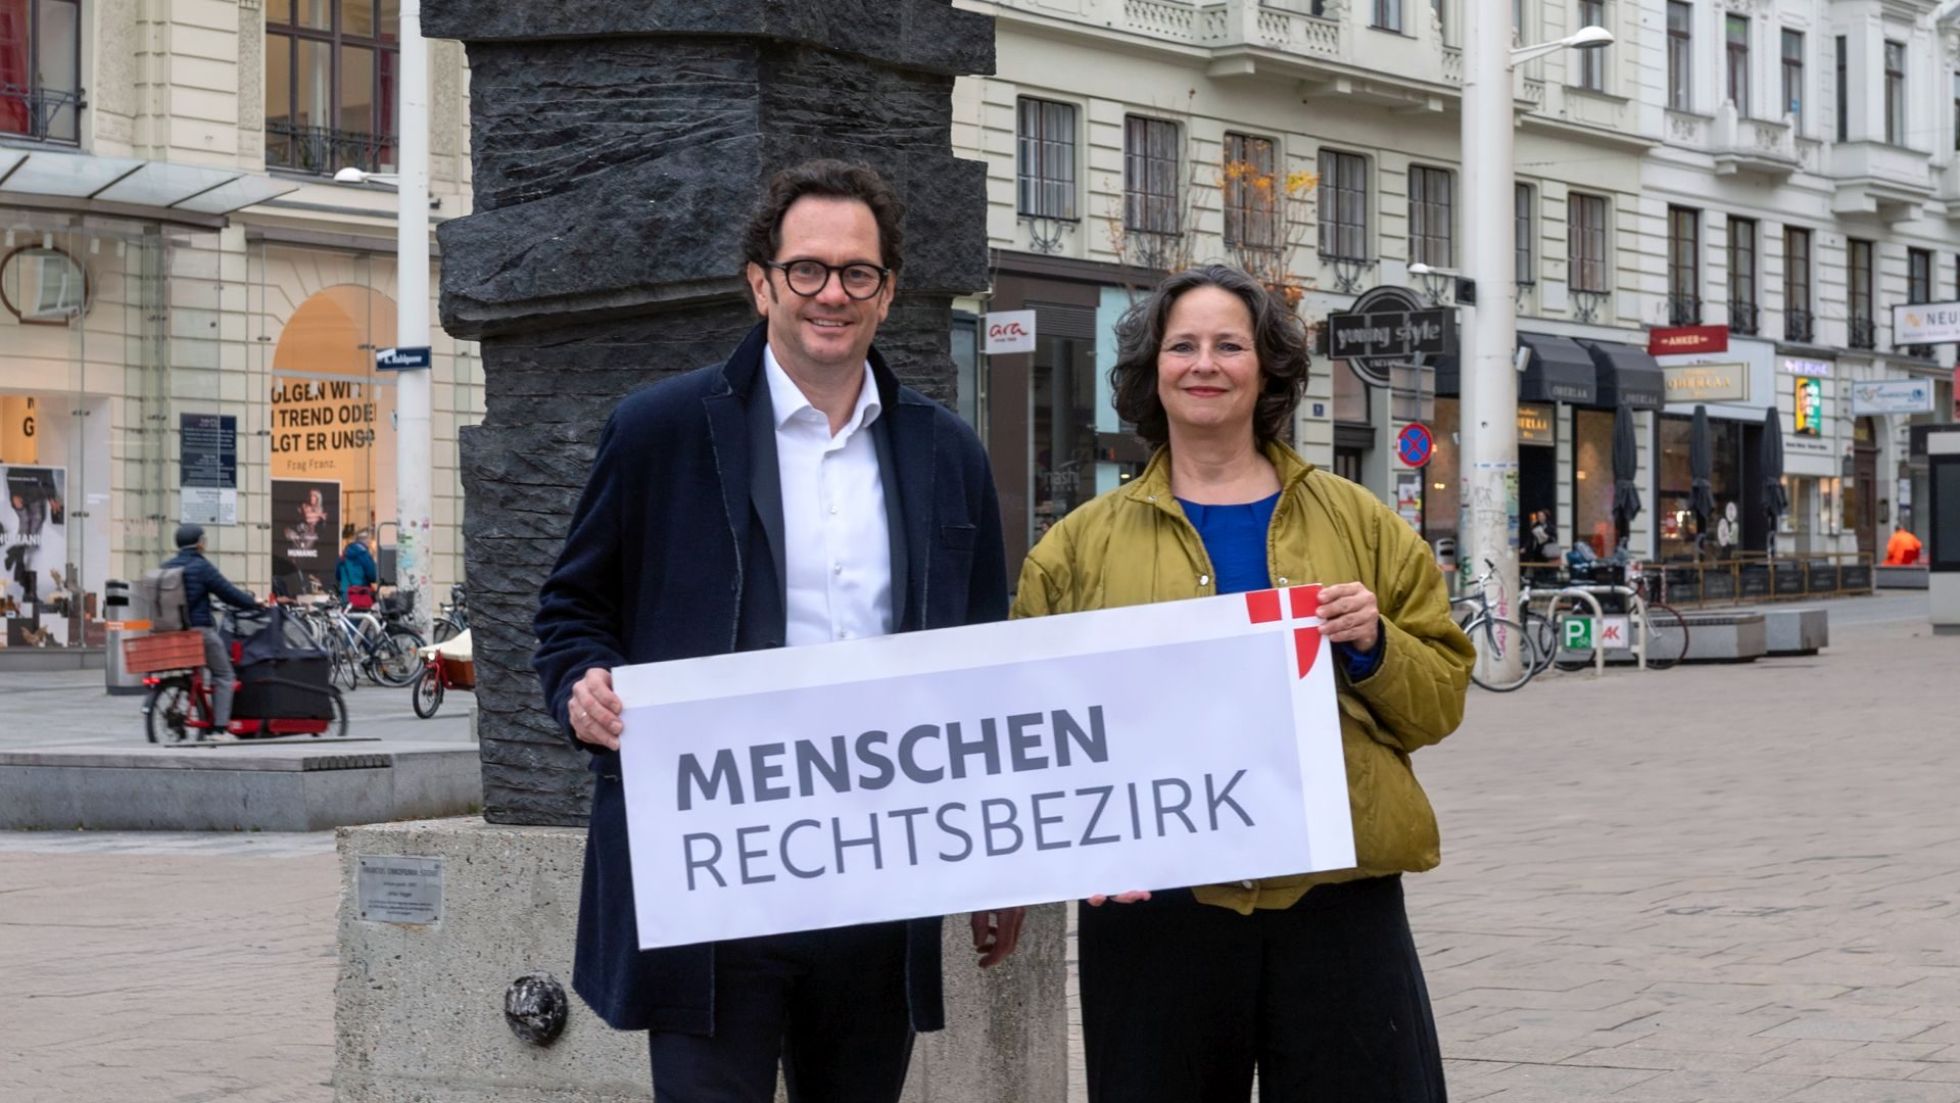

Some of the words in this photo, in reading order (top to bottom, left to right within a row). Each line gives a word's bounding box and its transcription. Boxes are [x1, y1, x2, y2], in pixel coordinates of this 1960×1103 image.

[1926, 311, 1960, 325] NEU
[989, 322, 1028, 338] ara
[1337, 327, 1390, 349] young
[1395, 320, 1440, 346] style
[1669, 335, 1699, 345] ANKER
[1552, 386, 1588, 399] OBERLAA
[279, 407, 334, 428] TREND
[338, 403, 377, 424] ODE
[306, 433, 327, 451] ER
[287, 459, 306, 472] Frag
[308, 458, 337, 470] Franz.
[287, 548, 318, 558] HUMANIC
[1566, 620, 1586, 647] P
[1602, 625, 1621, 640] AK
[676, 704, 1110, 811] MENSCHEN
[682, 769, 1256, 891] RECHTSBEZIRK
